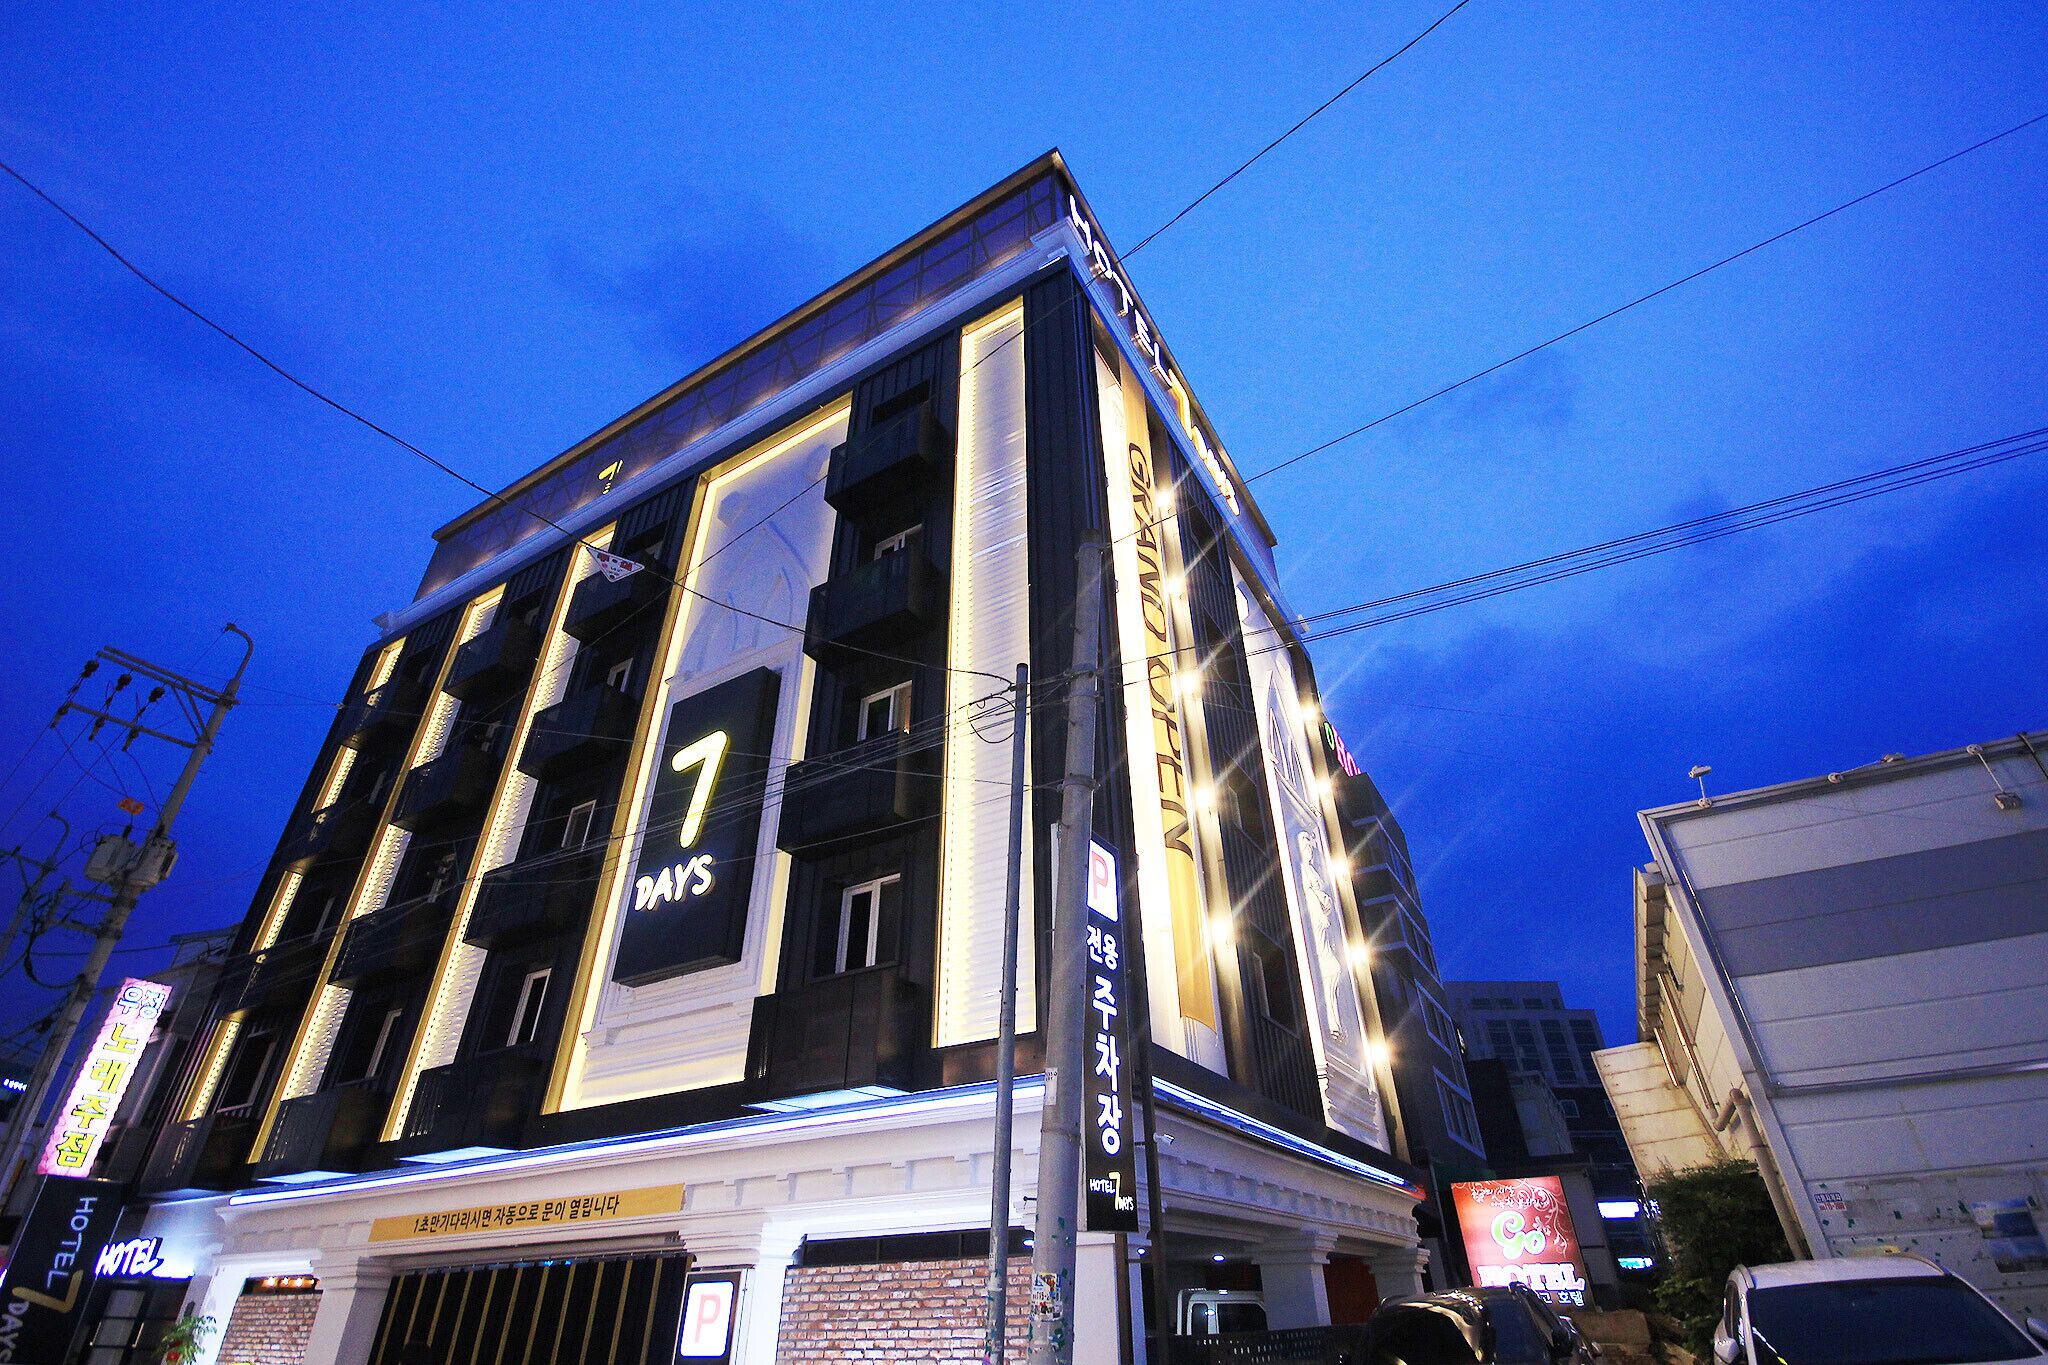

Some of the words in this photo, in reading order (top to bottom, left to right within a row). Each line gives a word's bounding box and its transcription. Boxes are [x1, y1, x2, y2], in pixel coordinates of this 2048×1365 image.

[1068, 193, 1173, 389] HOTEL
[1165, 368, 1194, 441] 7
[1128, 442, 1167, 643] GRAND
[1147, 656, 1194, 862] OPEN
[670, 729, 729, 849] 7
[634, 852, 714, 912] DAYS
[1091, 850, 1109, 900] P
[1086, 924, 1120, 971] 전용
[117, 986, 166, 1020] 우정
[1092, 974, 1123, 1156] 주차장
[56, 1022, 139, 1168] 노래주점
[494, 1203, 539, 1226] 자동으로
[542, 1200, 566, 1222] 문이
[569, 1194, 620, 1220] 열립니다
[1090, 1178, 1115, 1194] HOTEL
[1108, 1171, 1121, 1211] 7
[47, 1197, 98, 1290] HOTEL
[95, 1237, 159, 1278] HOTEL
[12, 1269, 84, 1314] 7
[694, 1294, 721, 1345] P
